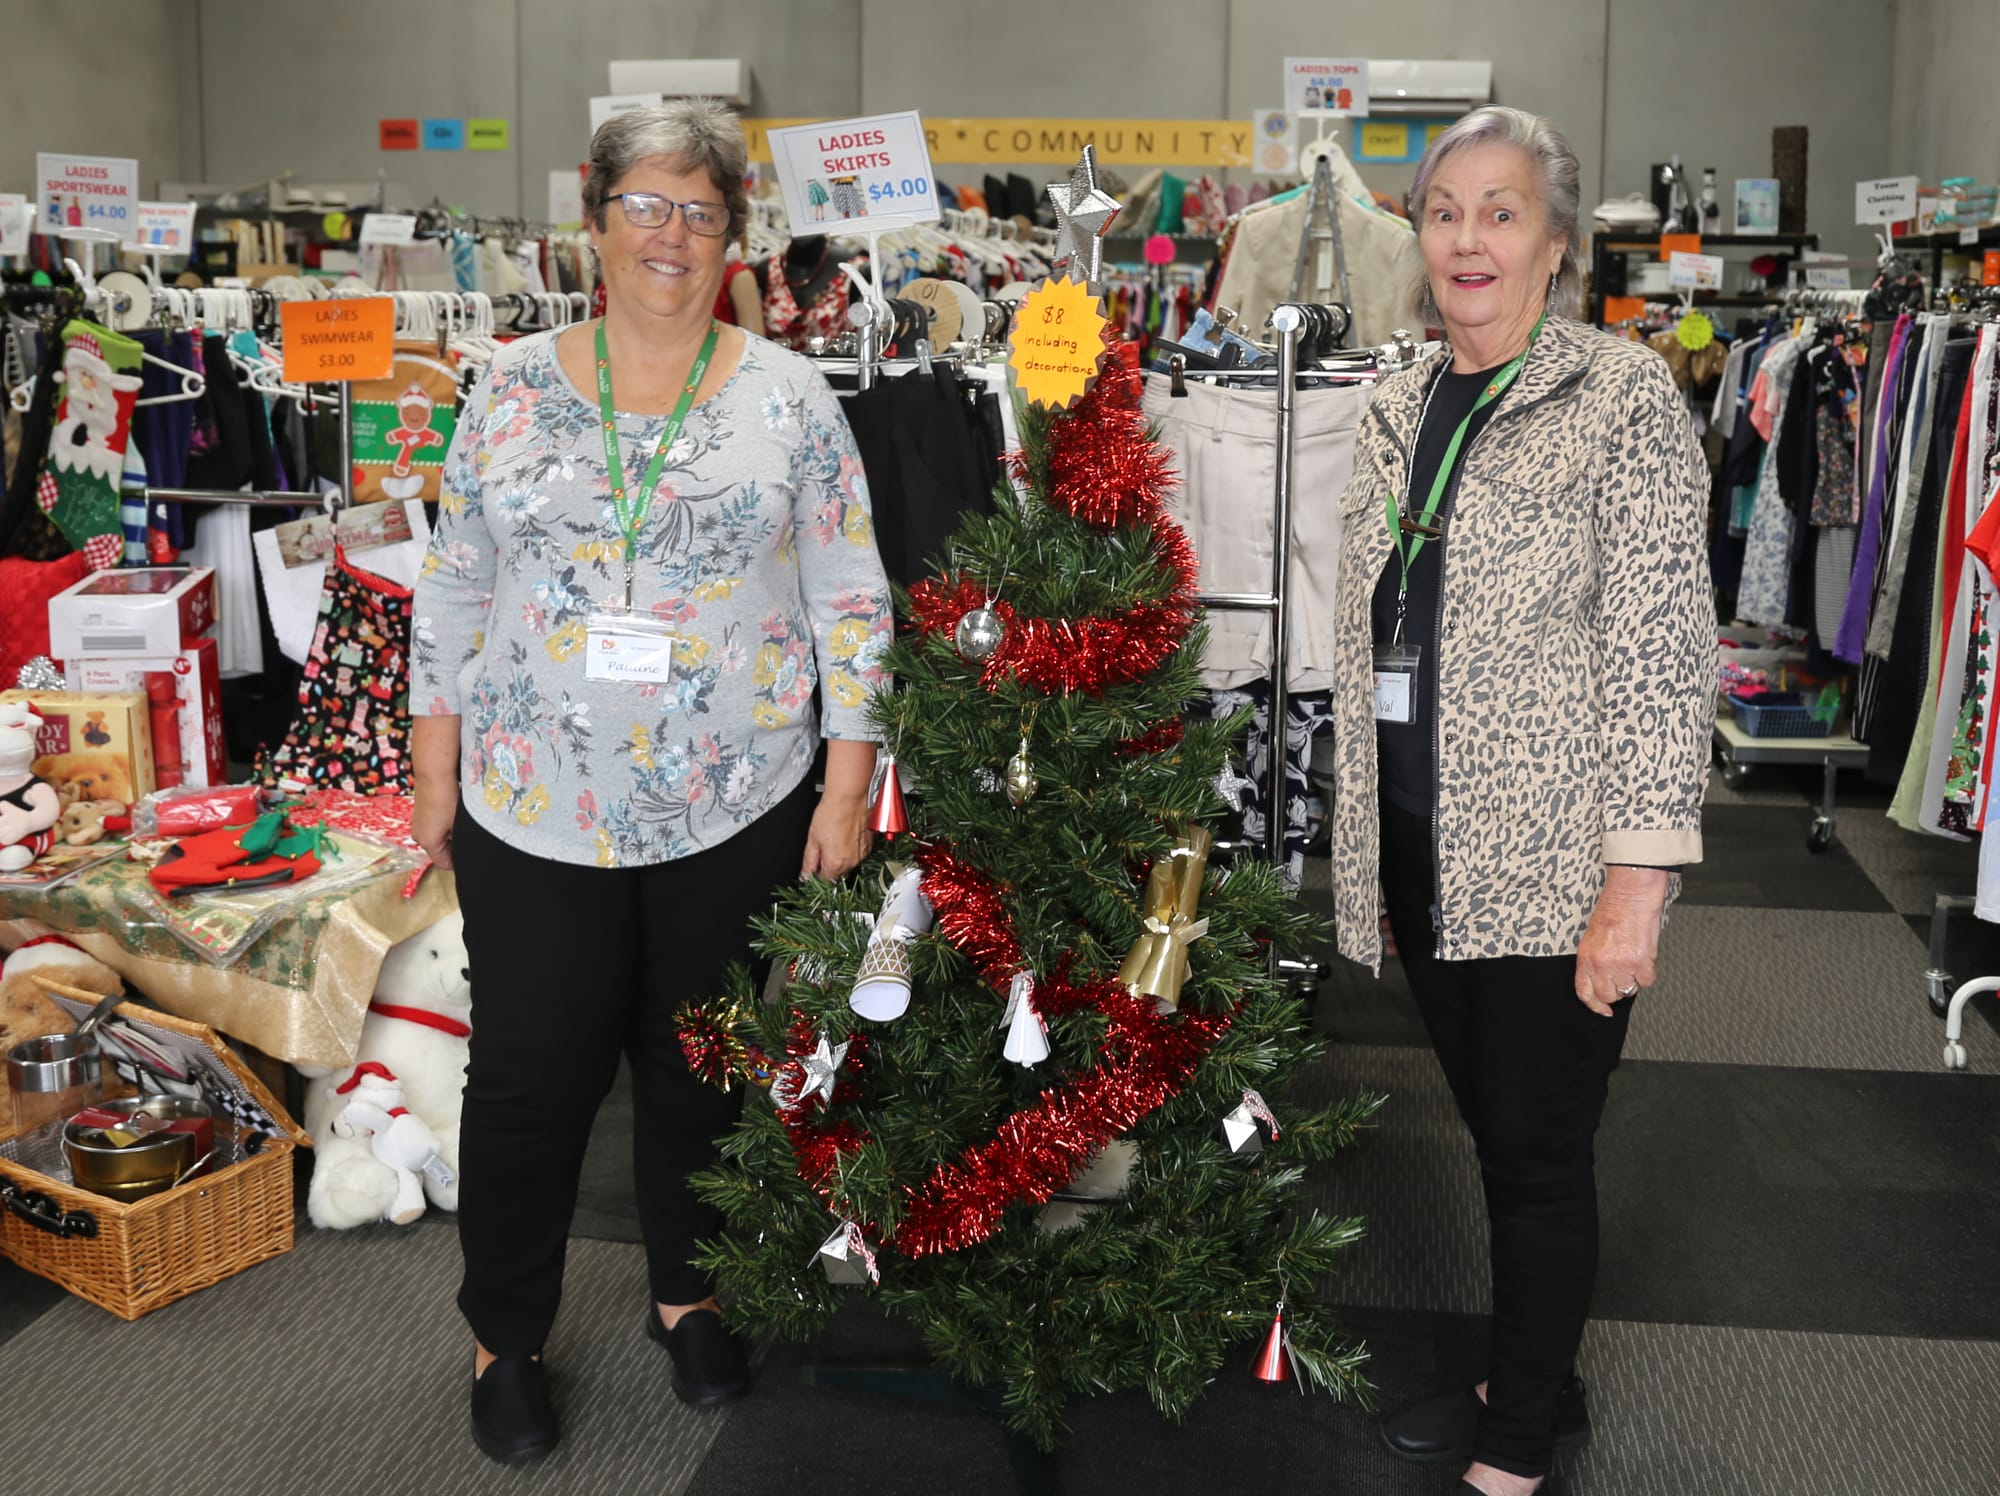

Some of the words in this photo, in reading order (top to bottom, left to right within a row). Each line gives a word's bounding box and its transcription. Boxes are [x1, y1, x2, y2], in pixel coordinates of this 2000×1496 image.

[1294, 65, 1330, 74] LADIES
[1333, 65, 1360, 74] TOPS
[818, 130, 885, 152] LADIES
[984, 130, 1247, 154] COMMUNITY
[823, 152, 891, 174] SKIRTS
[65, 165, 109, 180] LADIES
[46, 179, 128, 197] SPORTSWEAR
[868, 177, 928, 204] $4.00
[88, 204, 127, 219] $4.00
[316, 310, 359, 323] LADIES
[1042, 304, 1065, 325] $8
[300, 330, 375, 346] SWIMWEAR
[1025, 333, 1078, 355] including
[319, 353, 356, 368] $3.00
[1025, 356, 1094, 376] decorations
[1379, 700, 1394, 714] Val
